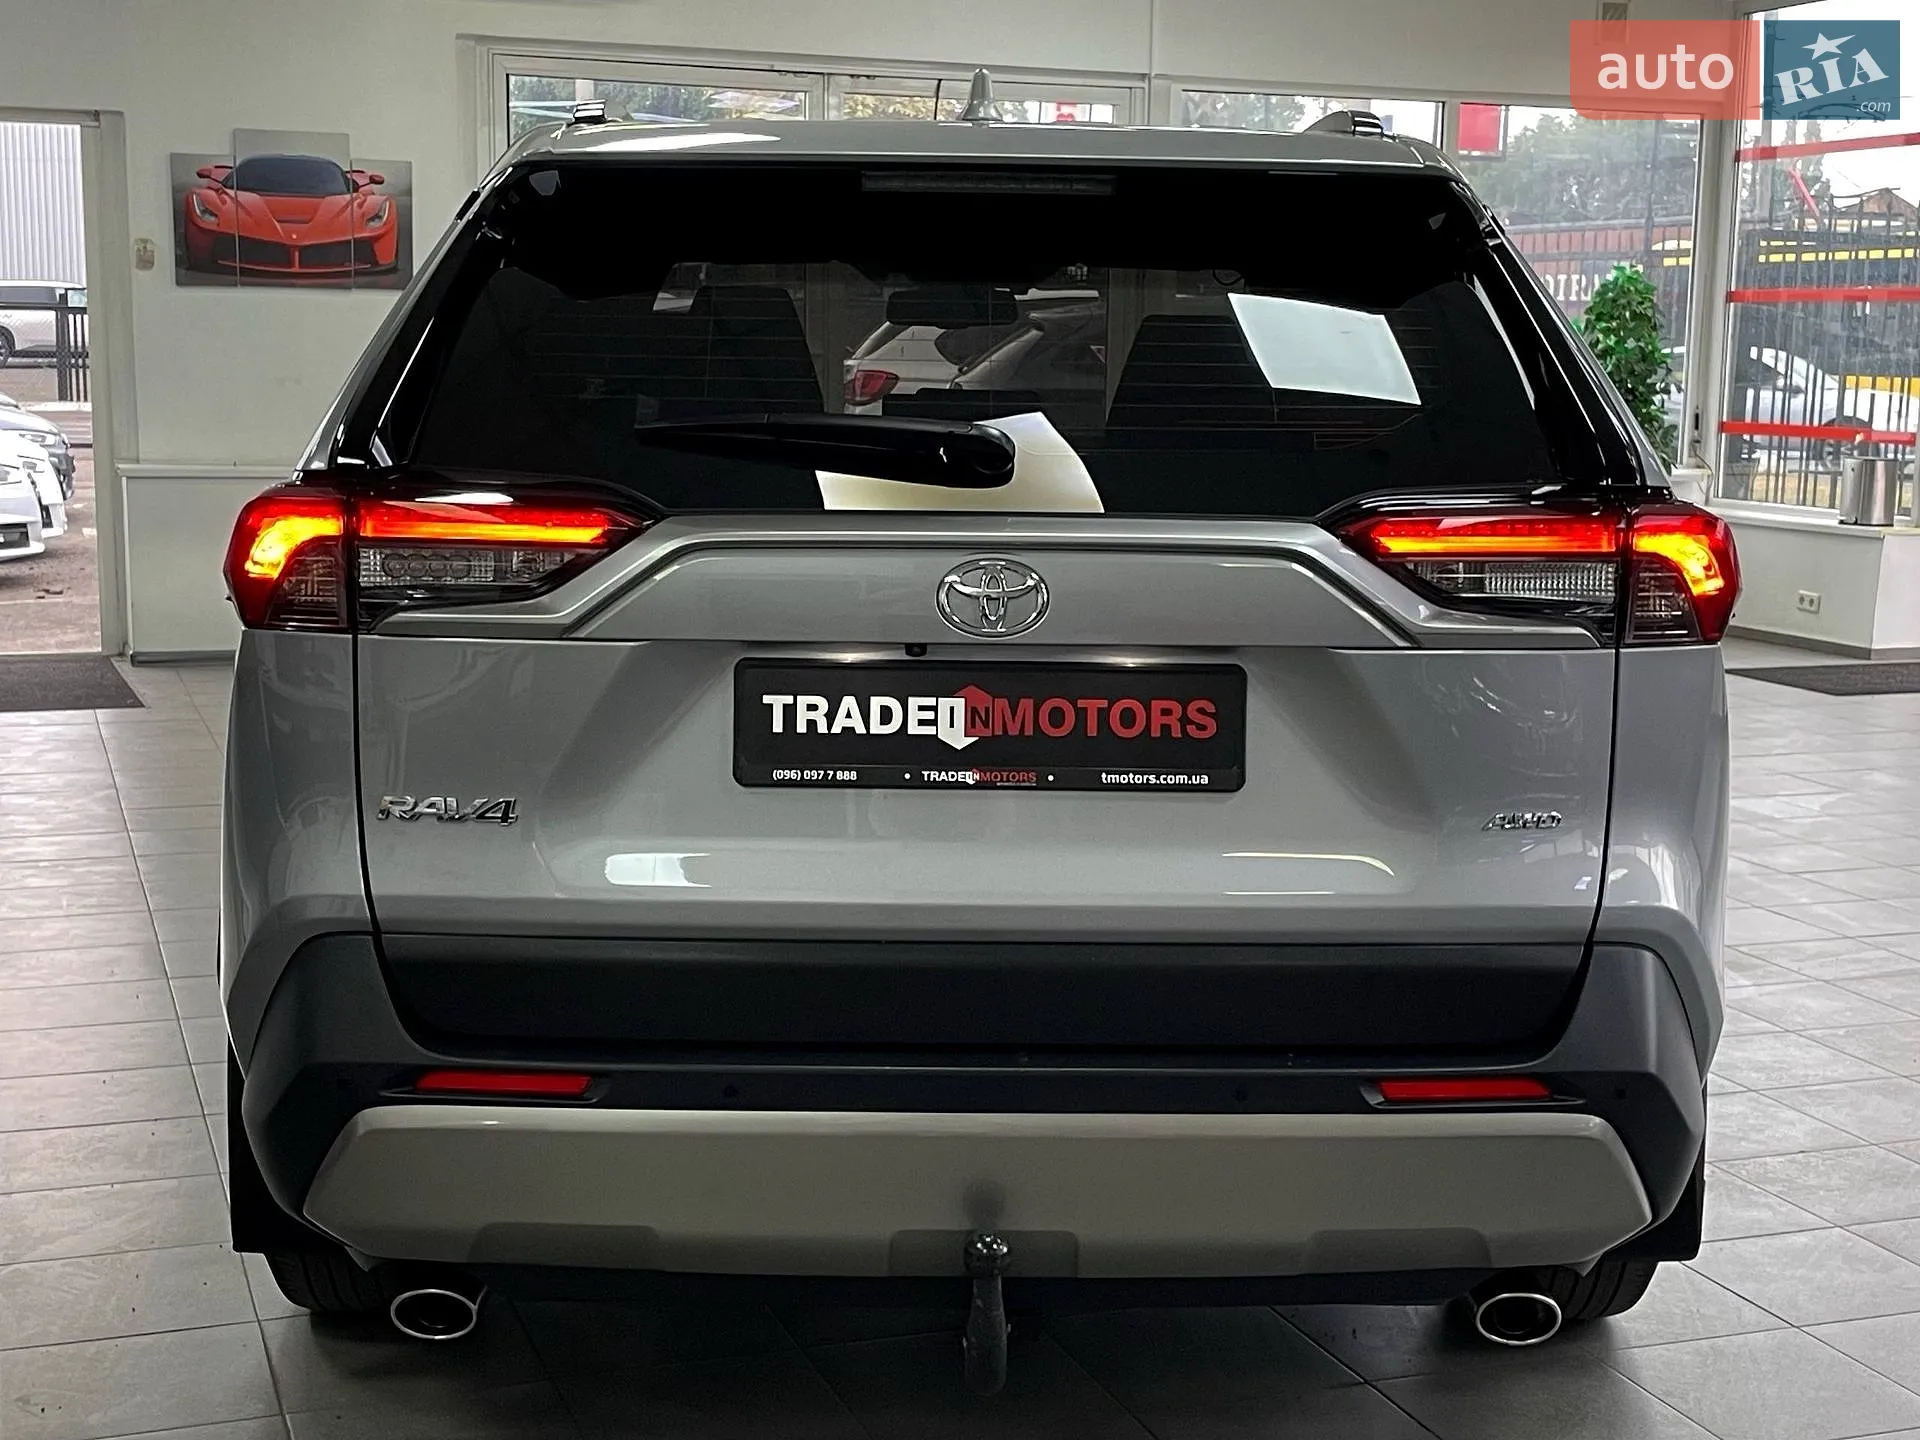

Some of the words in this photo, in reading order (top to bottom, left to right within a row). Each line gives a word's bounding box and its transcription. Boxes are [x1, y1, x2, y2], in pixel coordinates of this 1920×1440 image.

[772, 769, 800, 781] (096)
[803, 770, 824, 780] 097
[1100, 771, 1209, 785] tmotors.com.ua
[377, 795, 519, 827] RAV4
[1482, 810, 1563, 831] AWD
